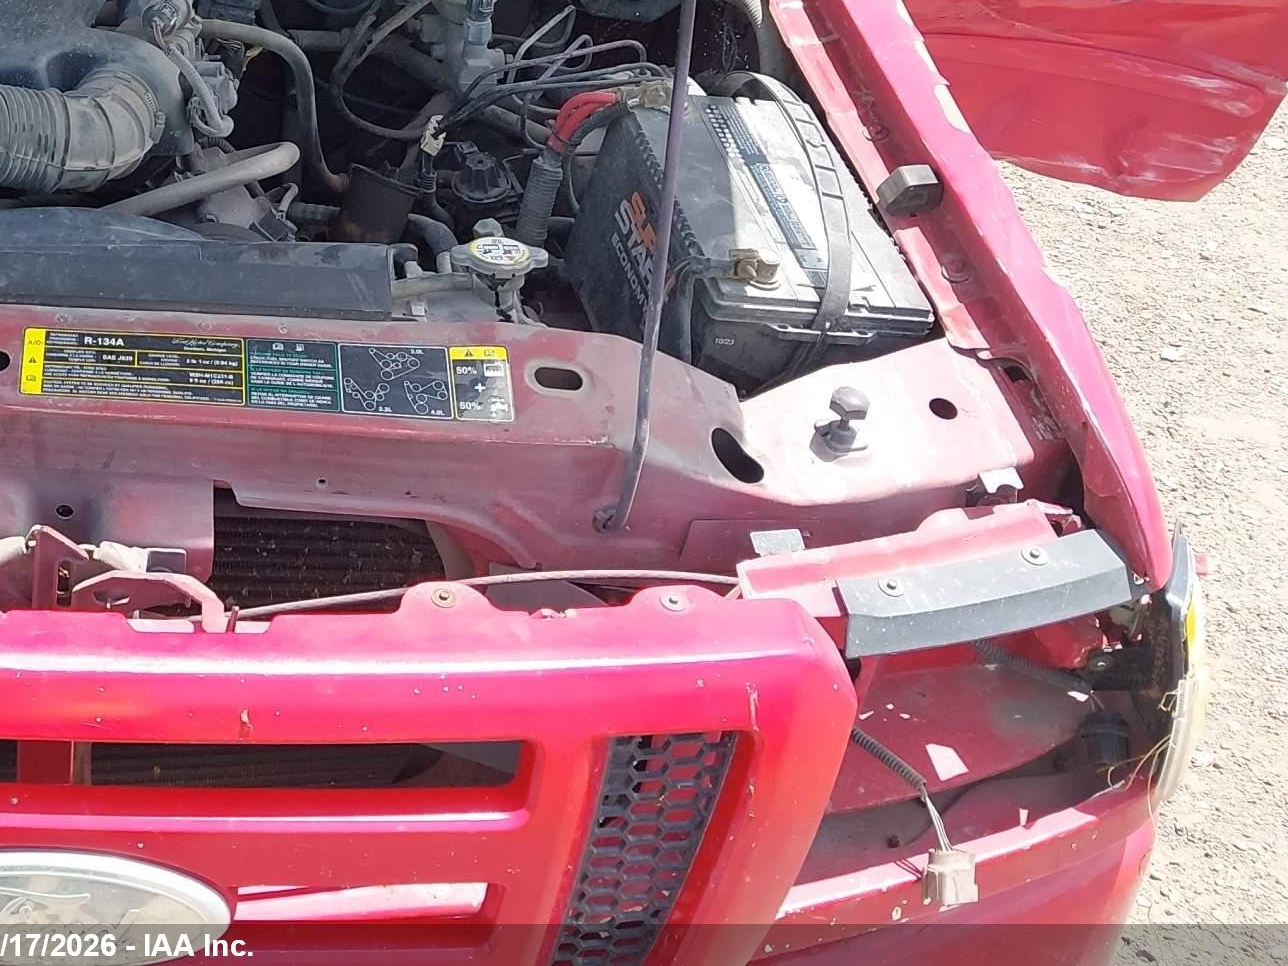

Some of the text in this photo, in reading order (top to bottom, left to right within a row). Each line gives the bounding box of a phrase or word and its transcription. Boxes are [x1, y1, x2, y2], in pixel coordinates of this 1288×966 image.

[84, 336, 127, 347] R-134A
[456, 366, 478, 375] 50%
[459, 402, 482, 410] 50%
